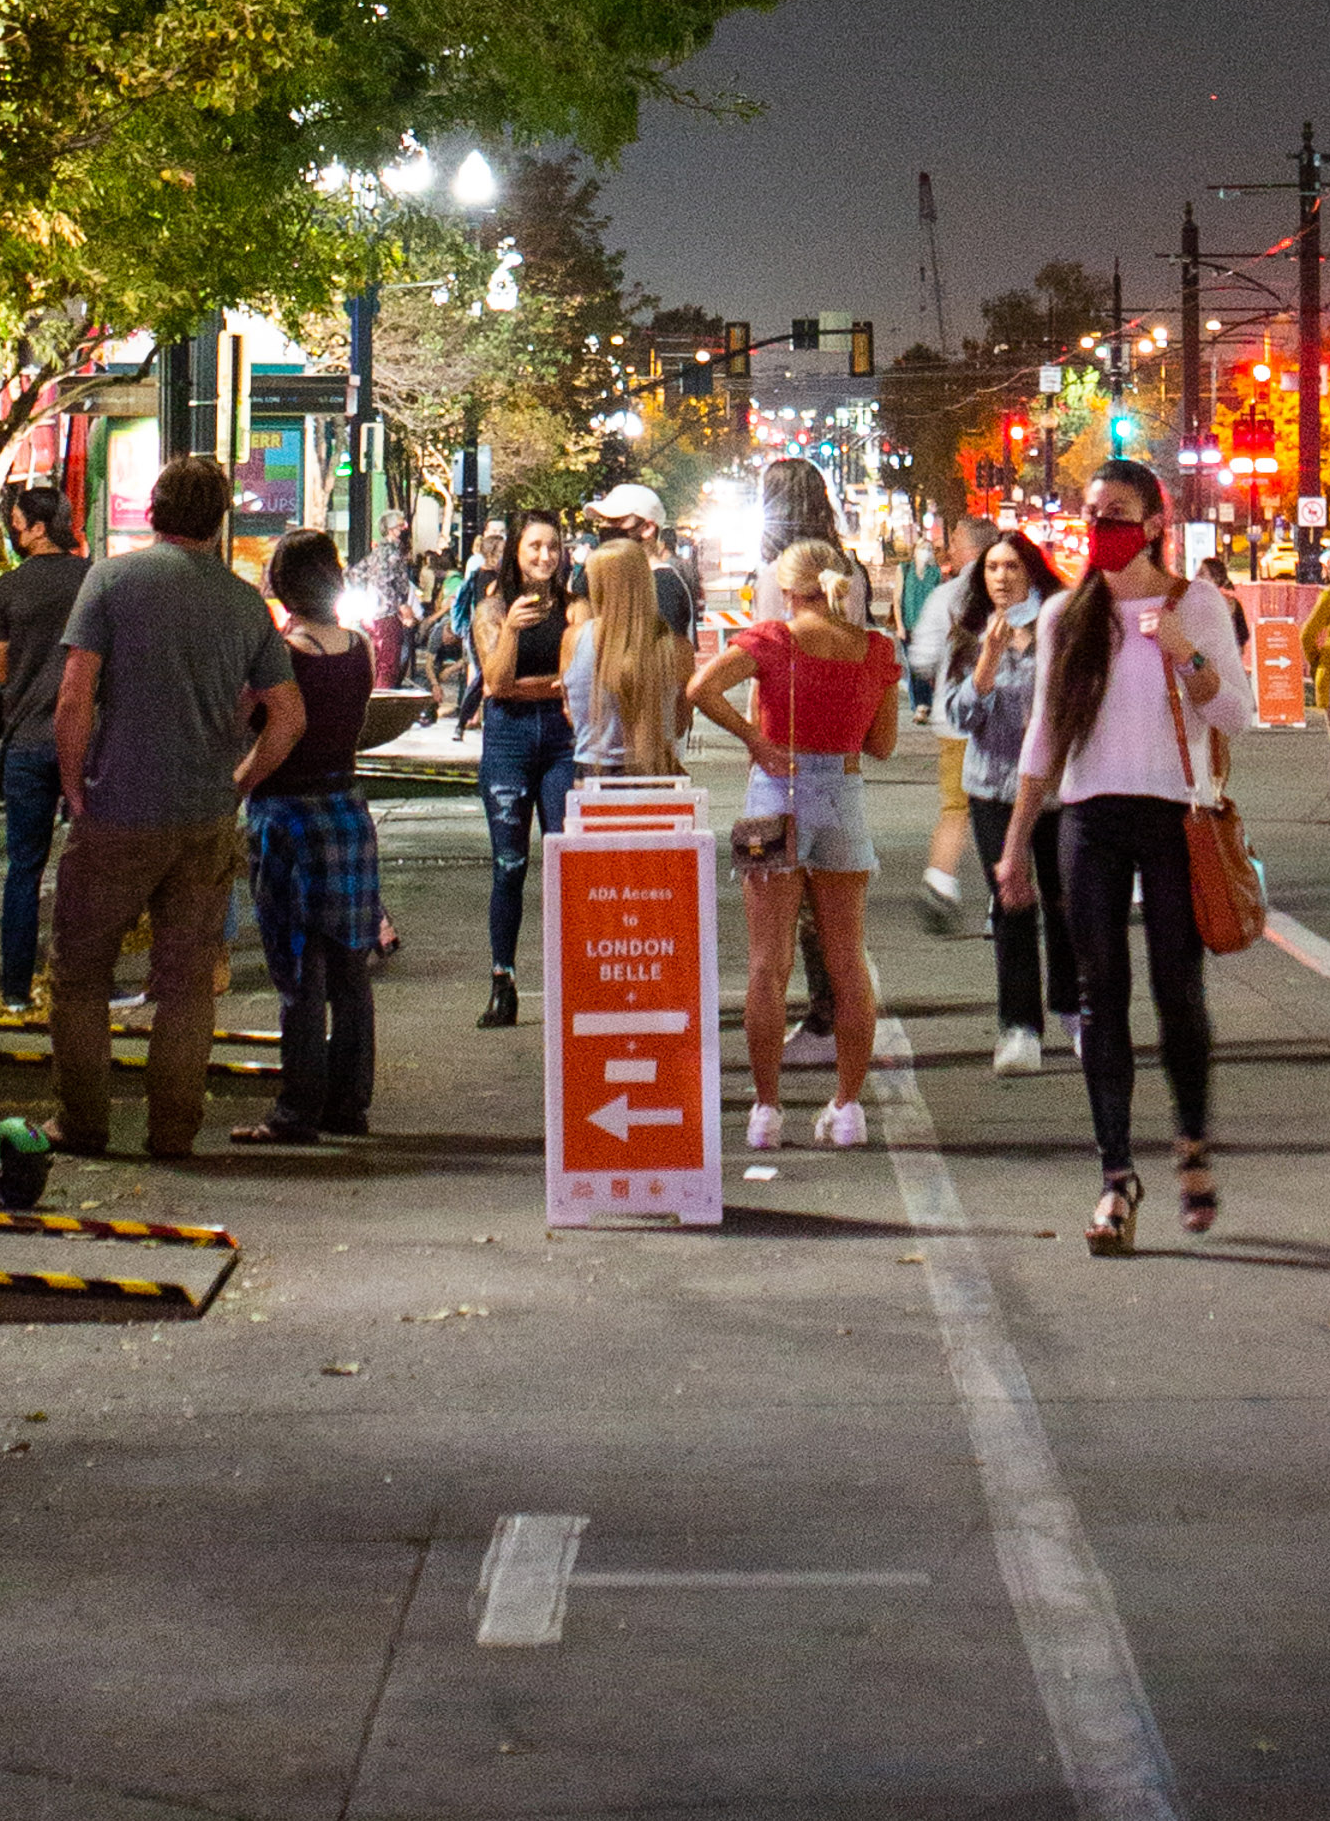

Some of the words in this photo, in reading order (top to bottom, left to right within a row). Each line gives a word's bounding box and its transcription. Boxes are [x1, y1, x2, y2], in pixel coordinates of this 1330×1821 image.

[250, 432, 282, 448] ERR
[588, 886, 618, 901] ADA
[622, 885, 673, 901] Access
[622, 912, 639, 927] to
[585, 938, 675, 958] LONDON
[599, 962, 662, 982] BELLE
